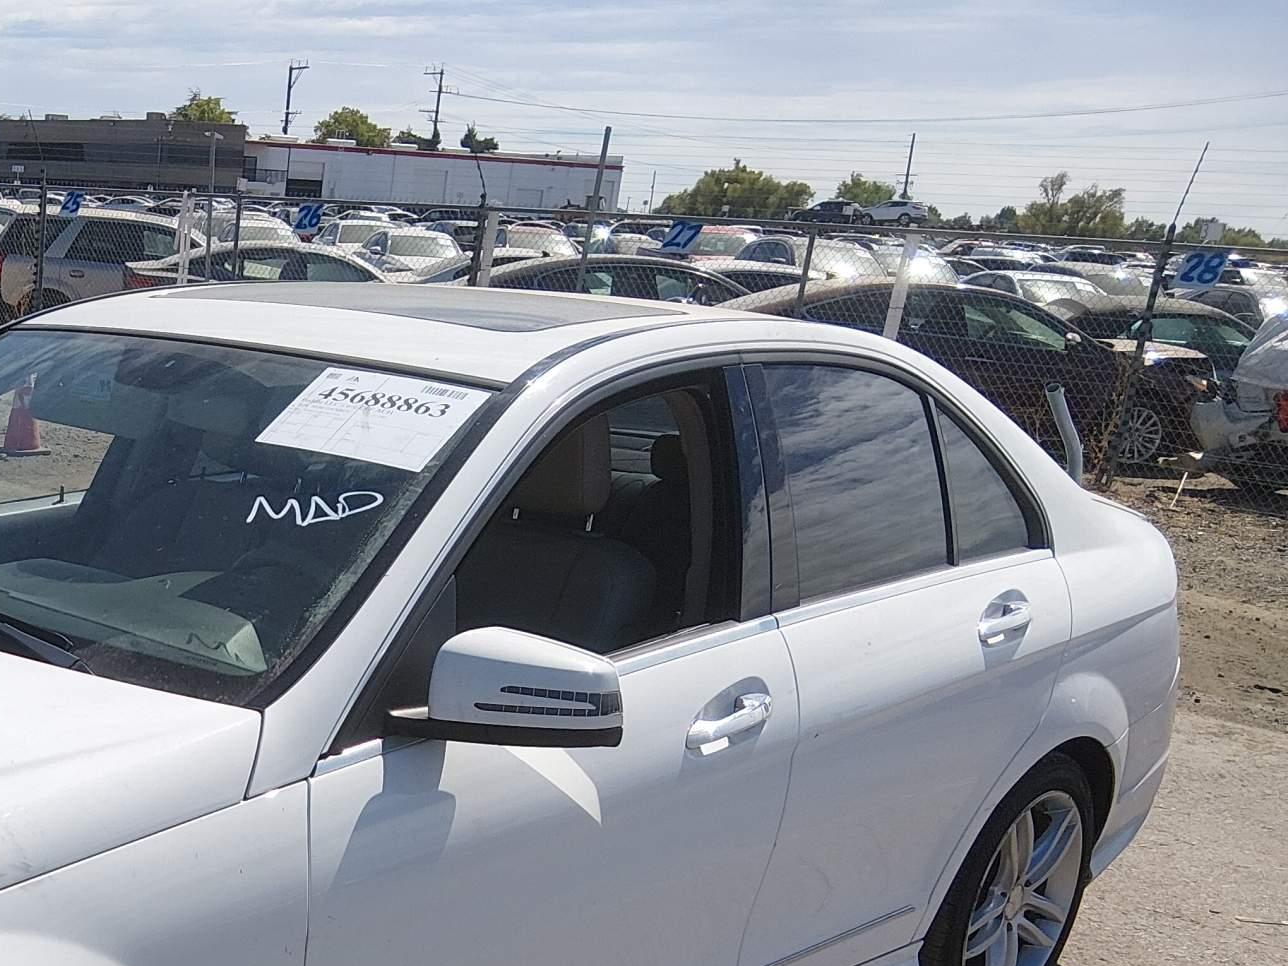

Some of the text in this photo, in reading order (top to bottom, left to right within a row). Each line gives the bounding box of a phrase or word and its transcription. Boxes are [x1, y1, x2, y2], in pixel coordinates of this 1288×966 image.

[62, 191, 84, 213] 25
[295, 204, 324, 229] 26
[662, 221, 703, 248] 27
[1180, 253, 1225, 283] 28
[318, 386, 450, 417] 45688863
